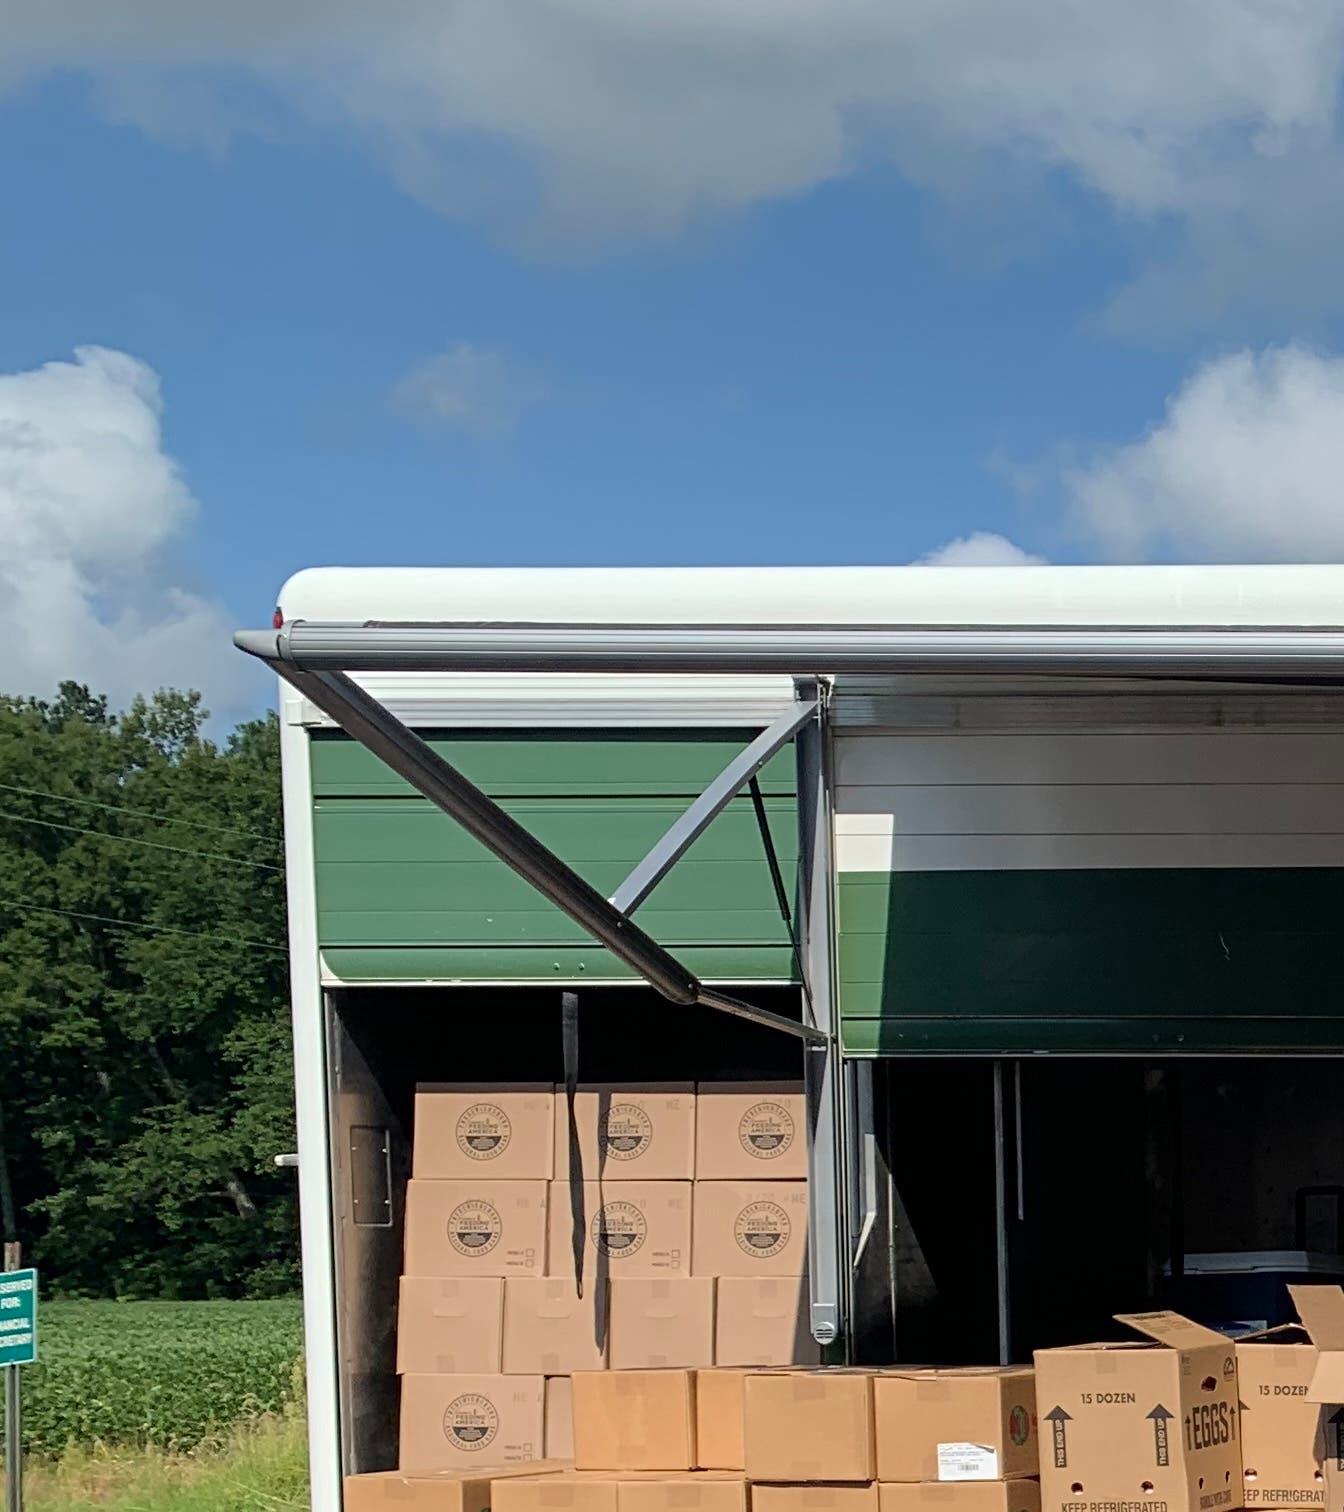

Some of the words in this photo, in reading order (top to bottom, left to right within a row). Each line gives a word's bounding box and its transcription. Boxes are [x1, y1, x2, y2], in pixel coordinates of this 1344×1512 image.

[1259, 1385, 1270, 1395] 15
[1081, 1393, 1093, 1404] 15
[1096, 1393, 1136, 1403] DOZEN
[1192, 1401, 1229, 1450] EGGS
[1243, 1489, 1259, 1501] EEP
[1262, 1489, 1325, 1502] REFRIGERAT
